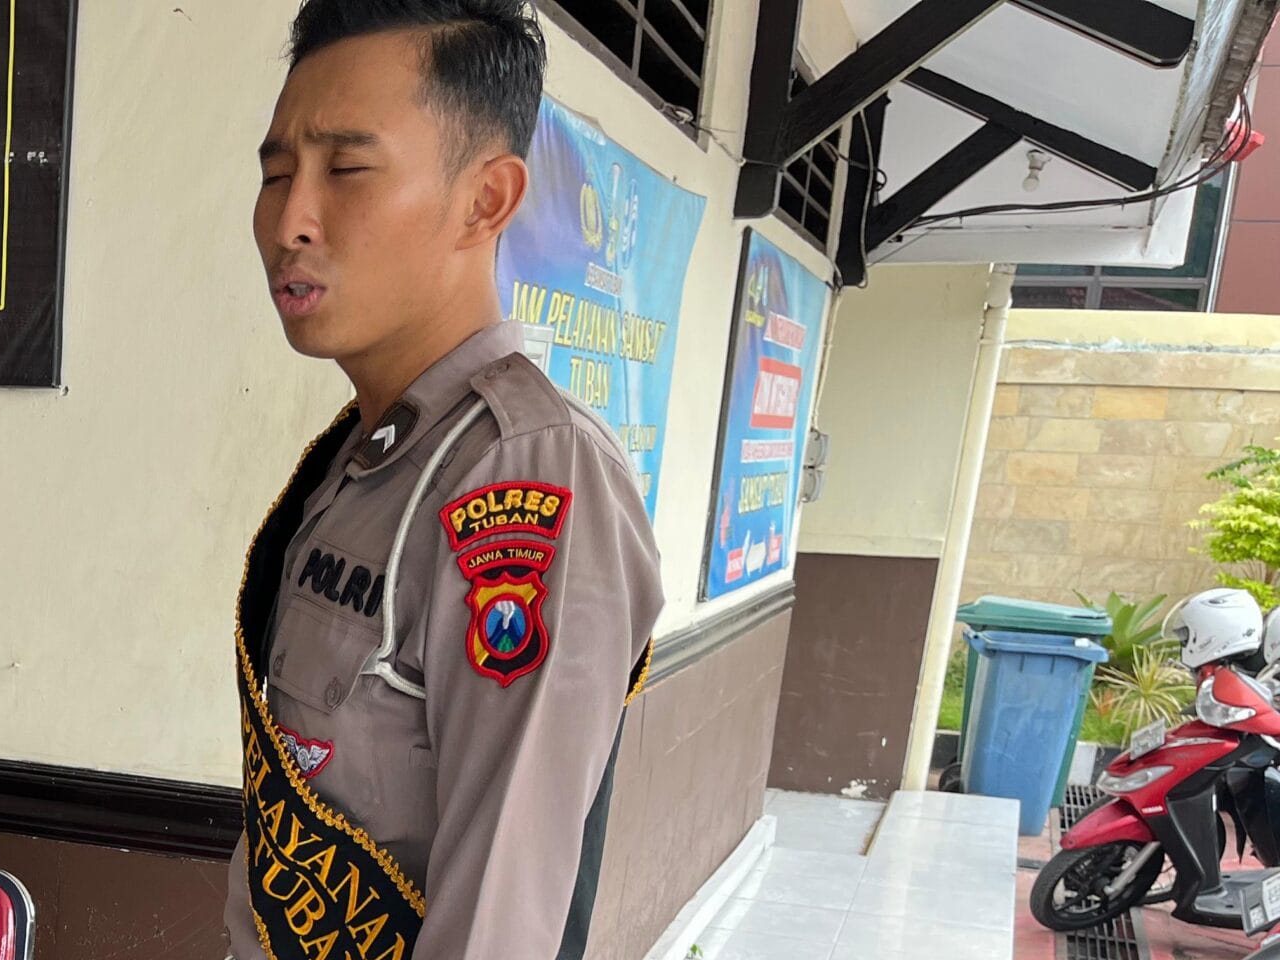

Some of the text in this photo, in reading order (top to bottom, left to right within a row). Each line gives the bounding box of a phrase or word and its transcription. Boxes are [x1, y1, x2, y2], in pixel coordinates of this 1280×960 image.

[510, 280, 547, 323] JAM
[546, 290, 618, 356] PELAYANAN
[620, 312, 667, 364] SAMSAT
[450, 489, 560, 533] POLRES
[469, 512, 539, 532] TUBAN
[468, 548, 545, 568] JAWA TIMUR
[298, 548, 386, 618] POLRI
